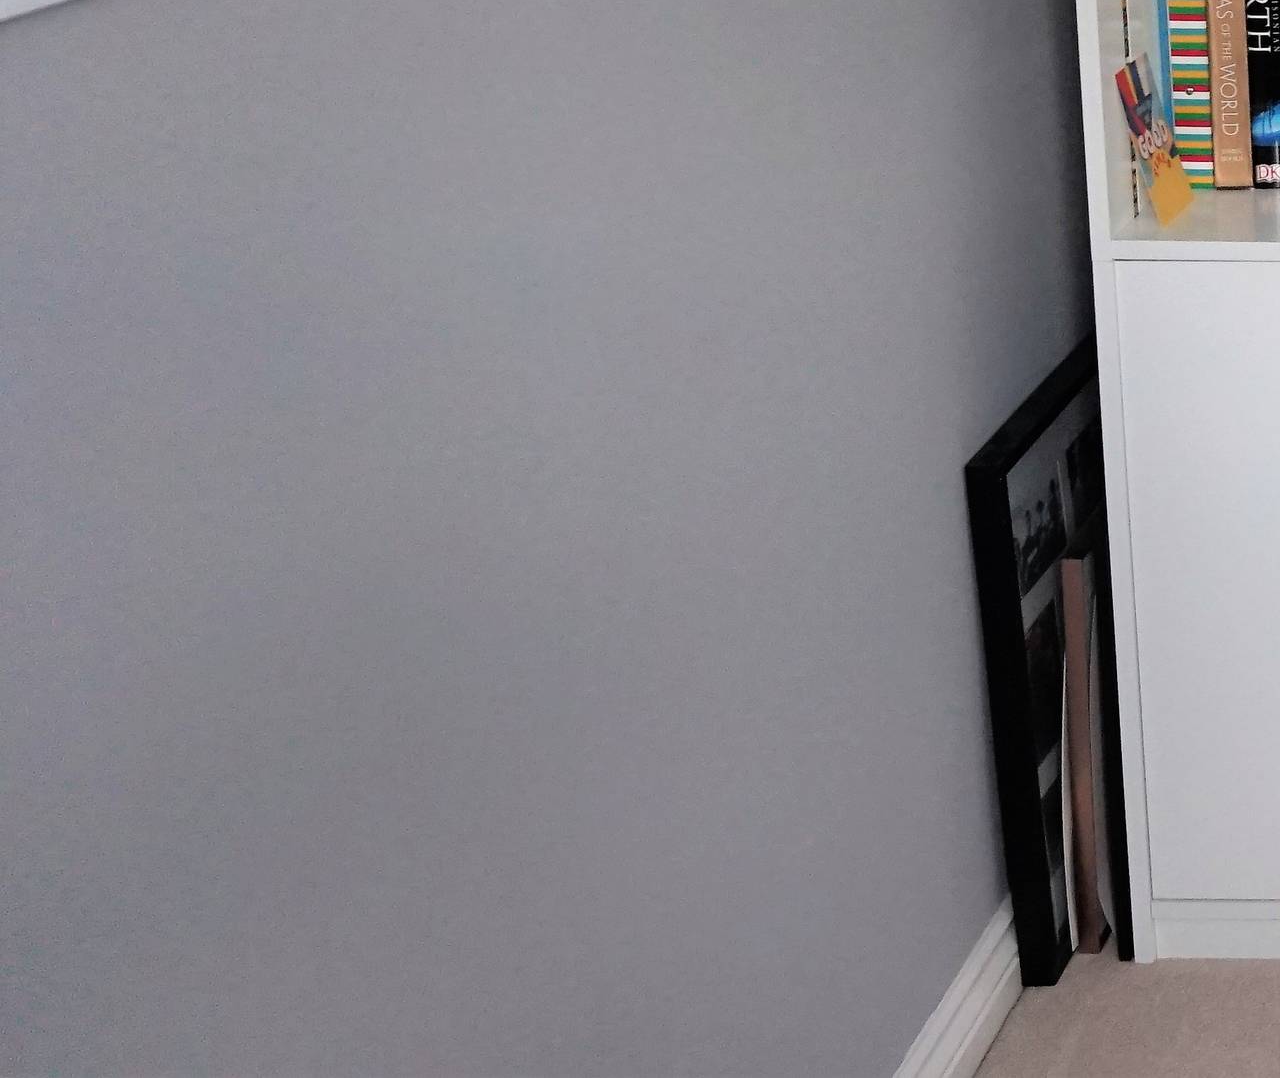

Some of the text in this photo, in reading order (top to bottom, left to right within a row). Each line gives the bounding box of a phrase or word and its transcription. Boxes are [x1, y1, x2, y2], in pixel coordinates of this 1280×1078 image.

[1221, 23, 1231, 38] OF
[1222, 41, 1233, 61] THE
[1219, 62, 1240, 137] WORLD
[1257, 165, 1280, 180] DK
